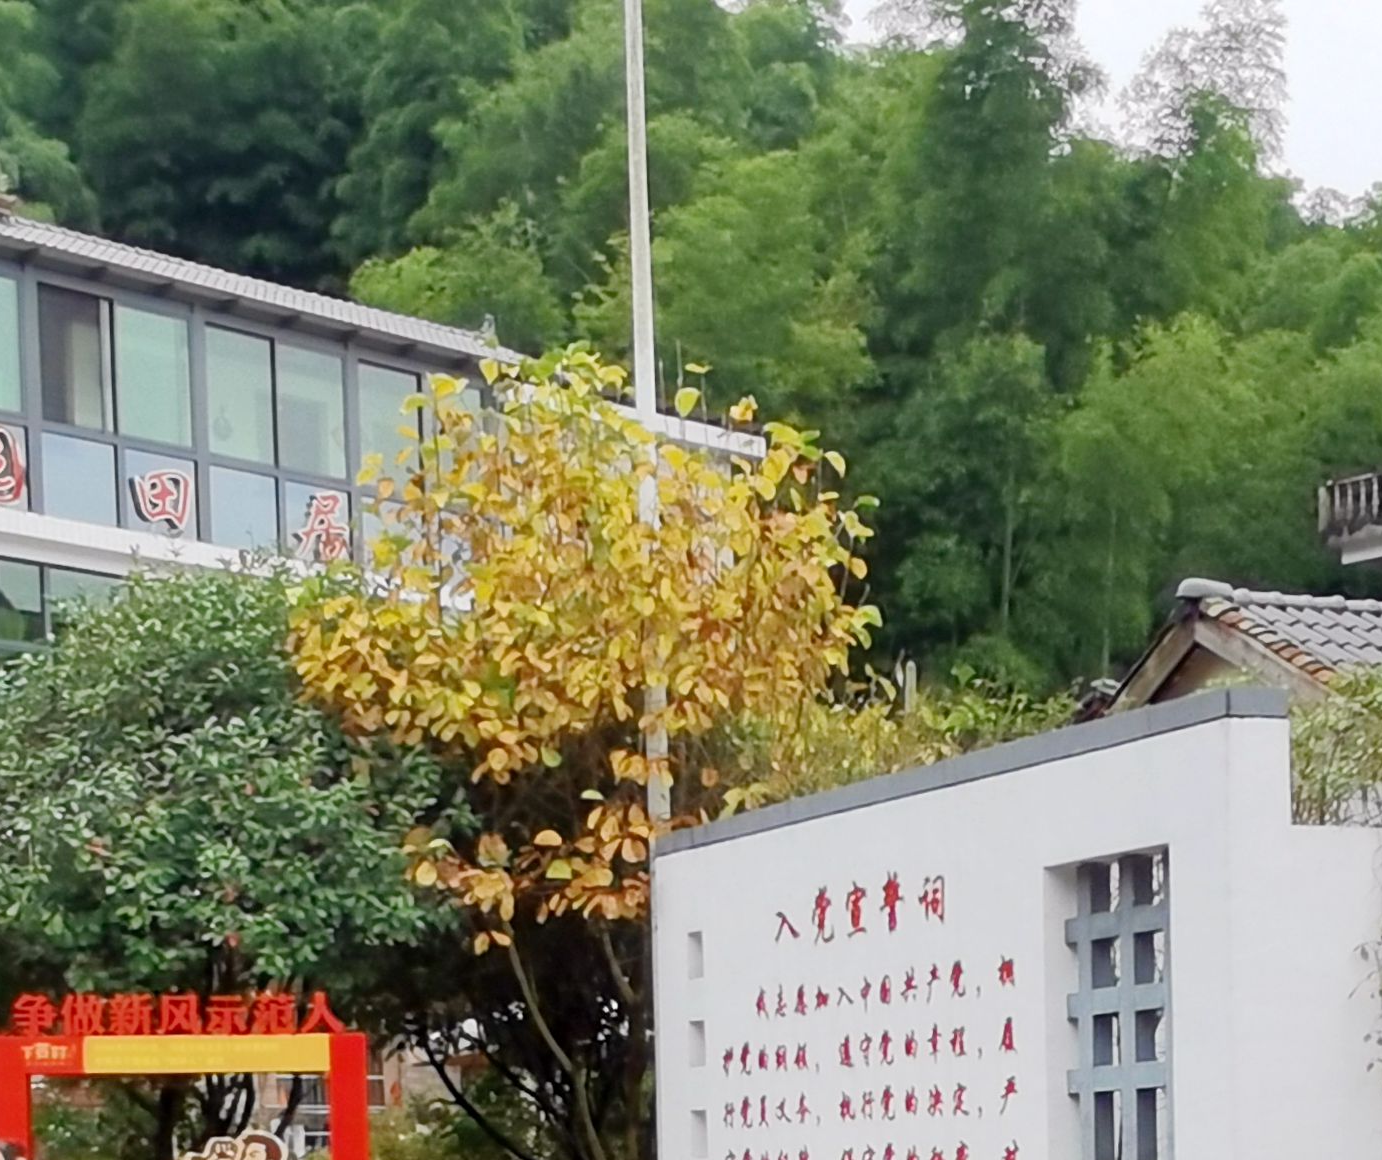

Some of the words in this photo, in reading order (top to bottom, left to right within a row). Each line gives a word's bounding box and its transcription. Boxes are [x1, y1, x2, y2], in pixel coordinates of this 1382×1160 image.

[775, 871, 945, 945] 入党宣誓词
[13, 992, 346, 1035] 争做新风示范人
